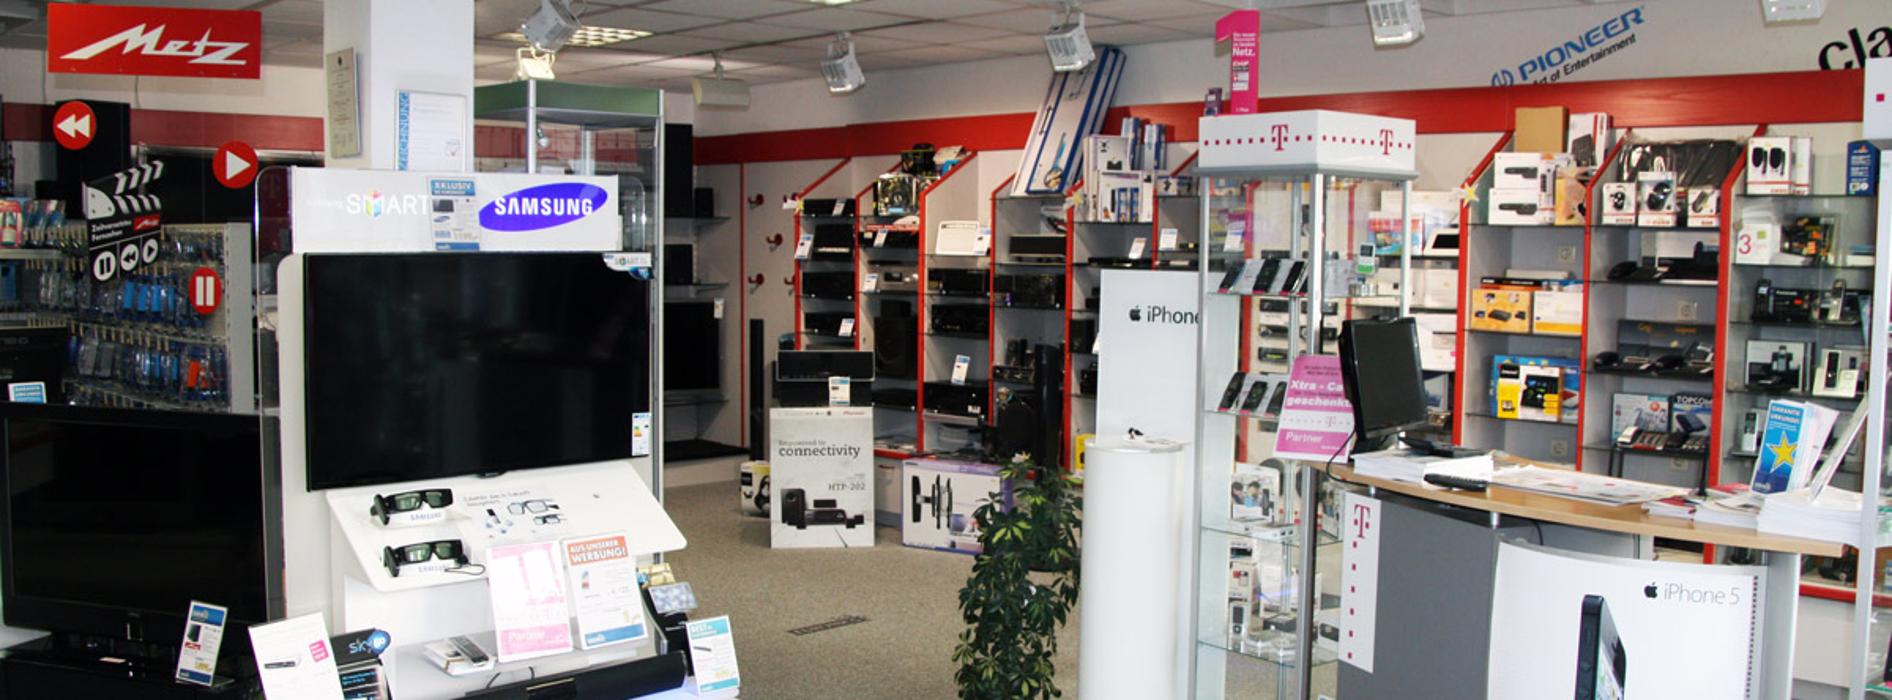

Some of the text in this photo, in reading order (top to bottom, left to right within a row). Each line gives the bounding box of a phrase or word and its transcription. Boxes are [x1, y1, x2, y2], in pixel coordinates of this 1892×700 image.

[59, 23, 249, 65] Metz
[1518, 7, 1645, 81] PIONEER
[1818, 27, 1892, 71] cla
[1551, 70, 1561, 83] of
[1563, 33, 1636, 75] Entertainment
[1271, 124, 1288, 151] T
[1380, 129, 1394, 155] T
[494, 197, 593, 216] SAMSUNG
[1738, 234, 1752, 254] 3
[1290, 380, 1317, 391] Xtra
[1286, 431, 1323, 443] Partner
[779, 444, 861, 459] connectivity
[828, 483, 865, 491] HTP-202
[1353, 503, 1370, 539] T
[570, 547, 626, 563] WERBUNG!
[1665, 582, 1741, 605] iPhone 5
